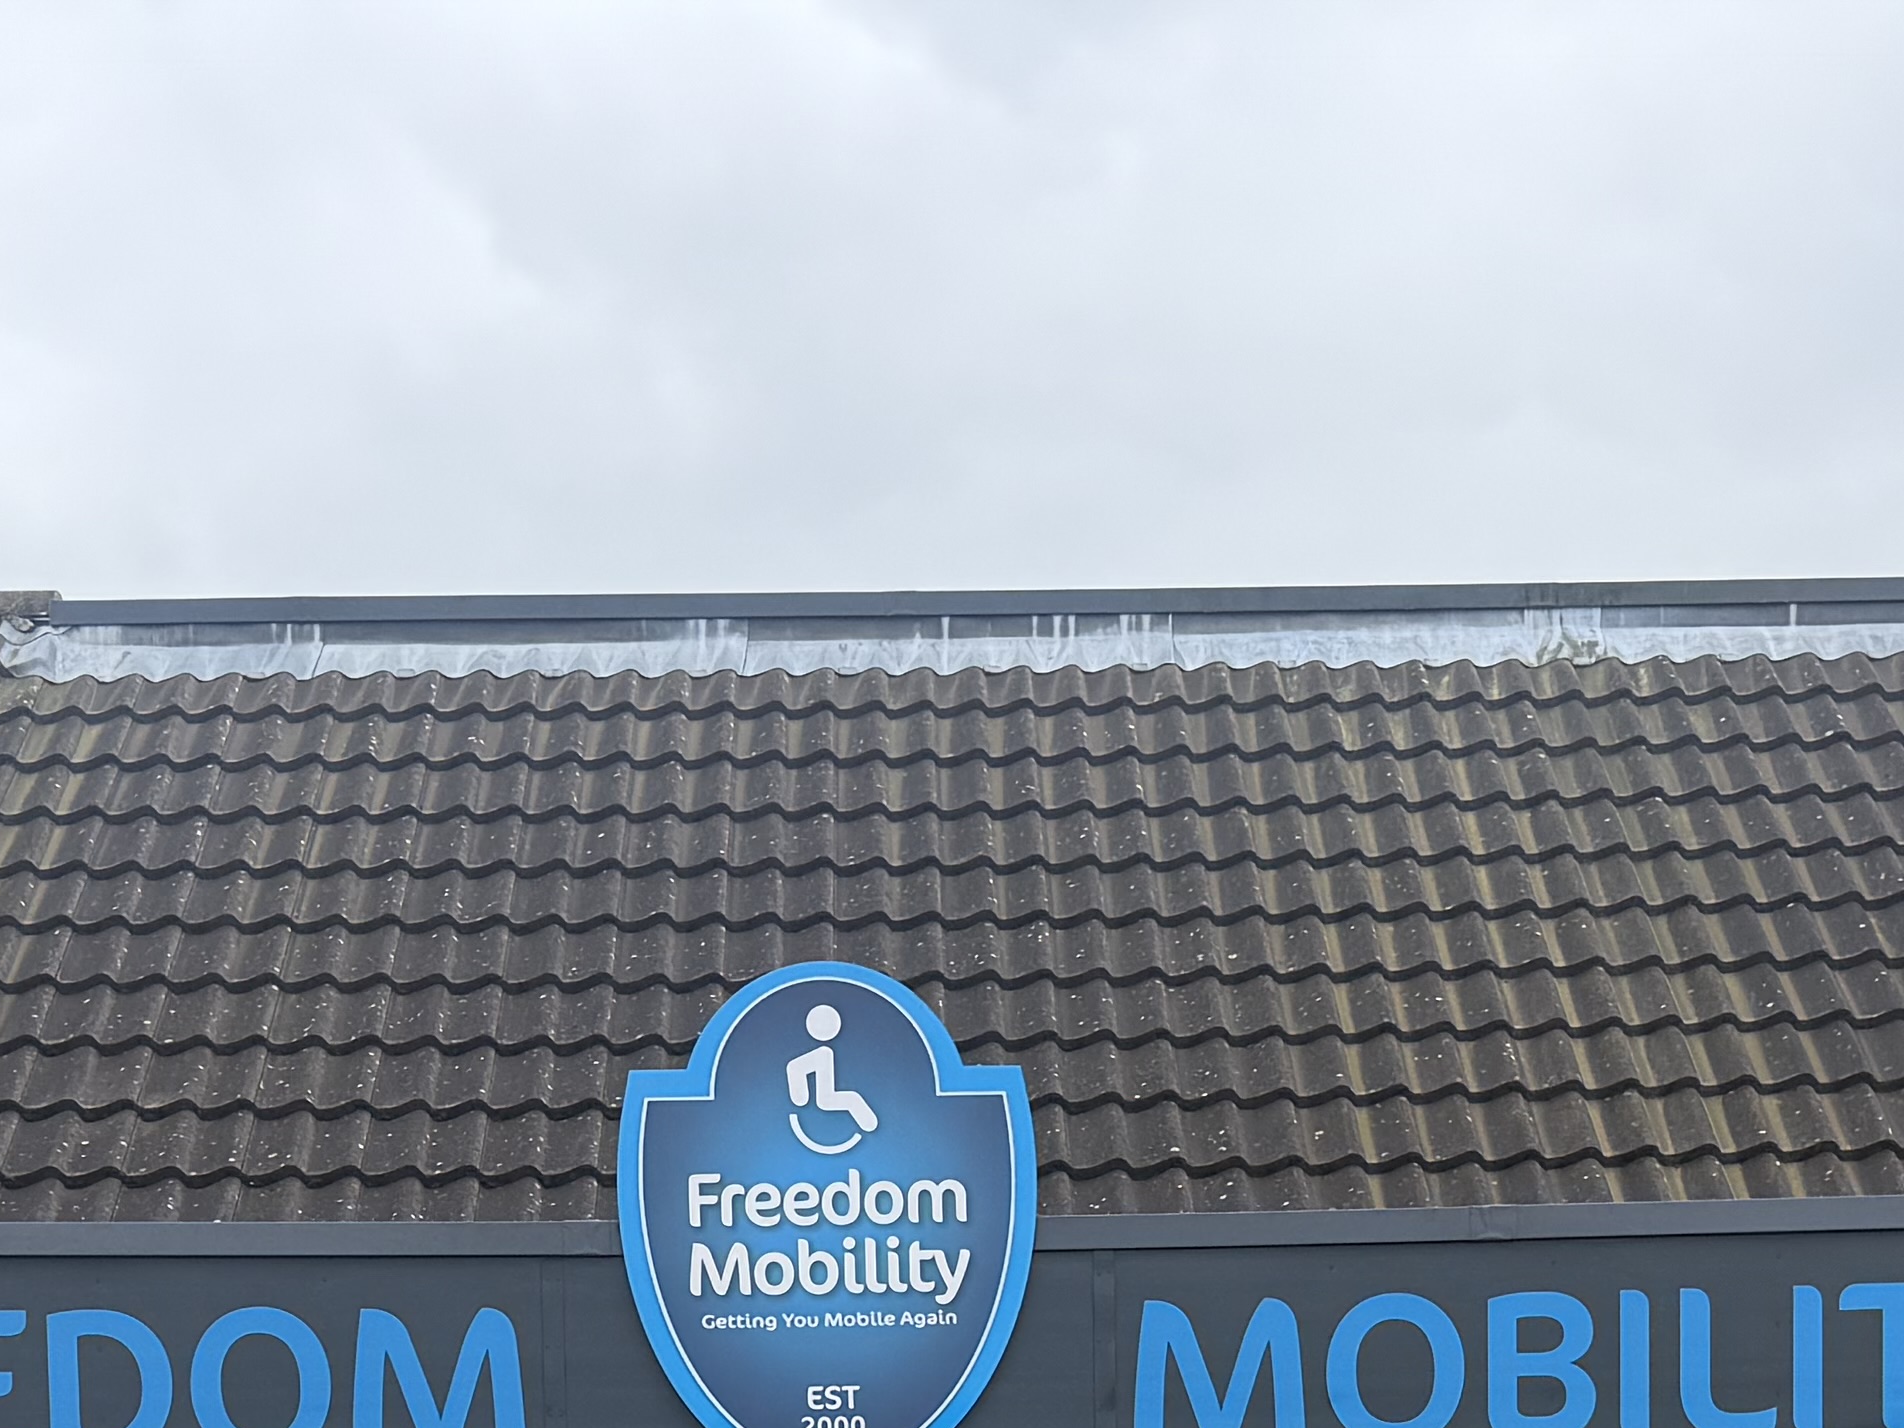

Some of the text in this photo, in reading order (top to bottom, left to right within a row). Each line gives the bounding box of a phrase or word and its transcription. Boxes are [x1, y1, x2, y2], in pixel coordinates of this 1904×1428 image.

[688, 1168, 967, 1228] Freedom
[689, 1236, 971, 1305] Mobility
[701, 1309, 958, 1332] Getting You Mobile Again
[807, 1385, 861, 1410] EST
